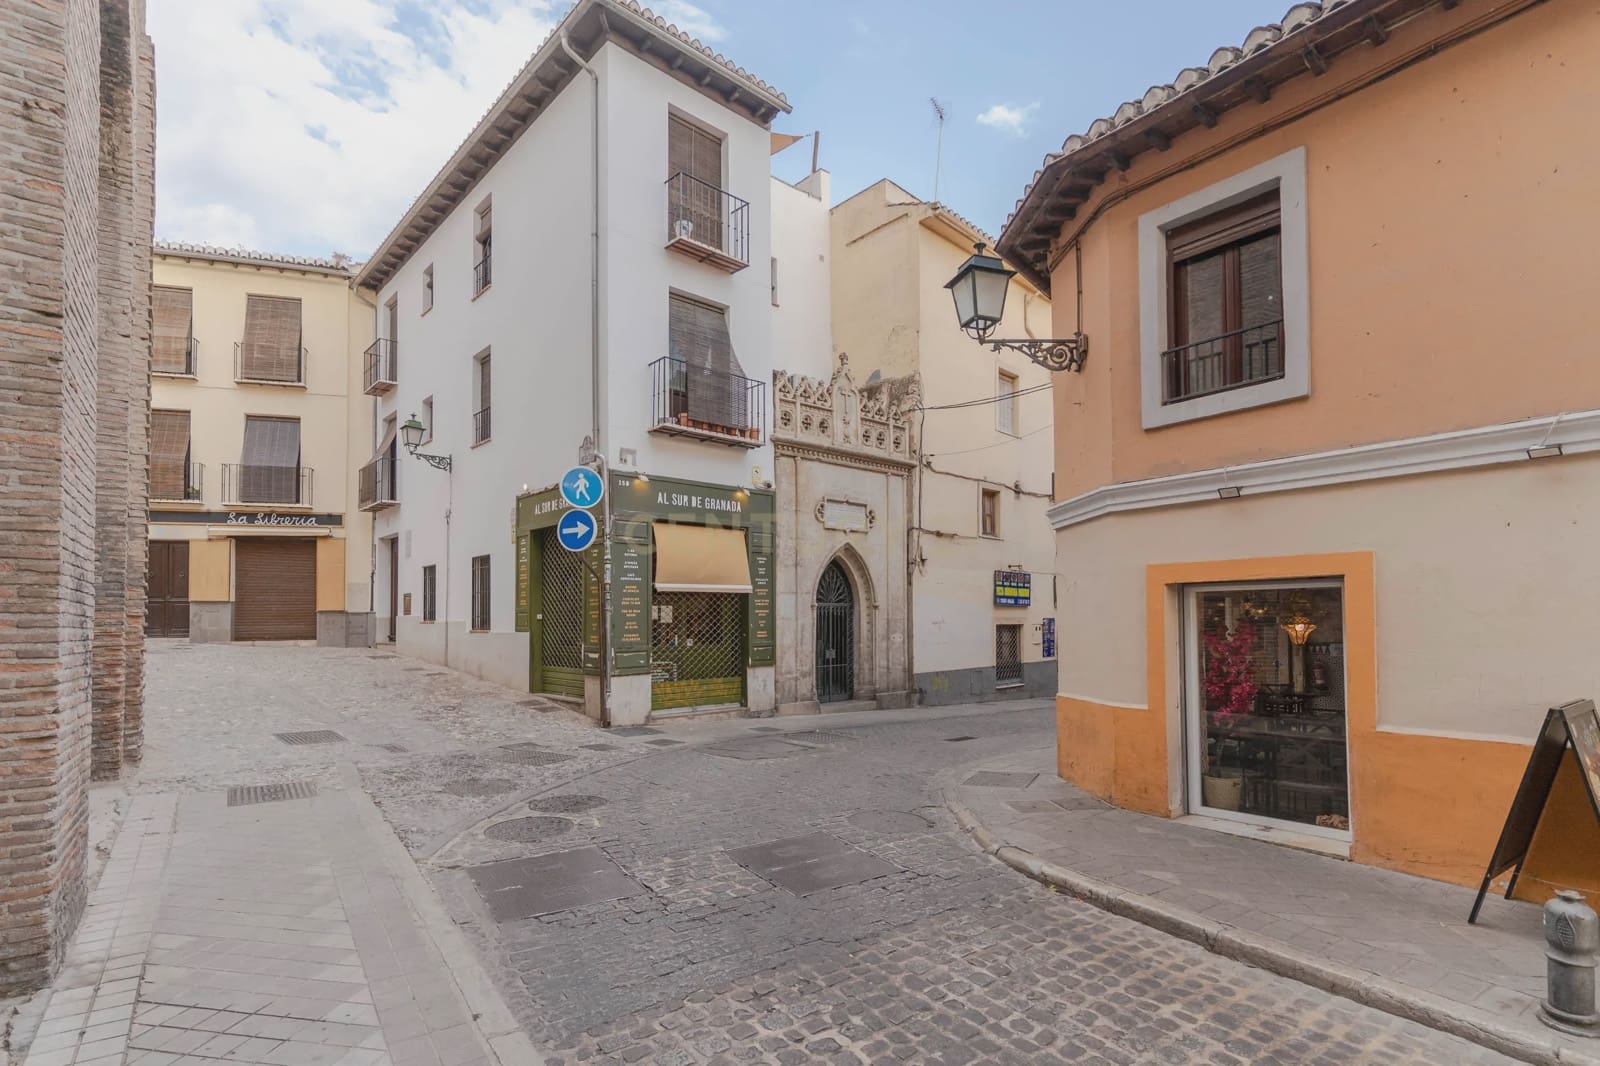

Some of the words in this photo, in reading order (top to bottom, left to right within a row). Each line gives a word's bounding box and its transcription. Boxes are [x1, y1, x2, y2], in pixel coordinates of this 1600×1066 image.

[657, 491, 669, 505] AL
[671, 493, 688, 507] SUR
[691, 495, 702, 509] DE
[704, 498, 742, 513] GRANADA
[227, 512, 248, 524] La
